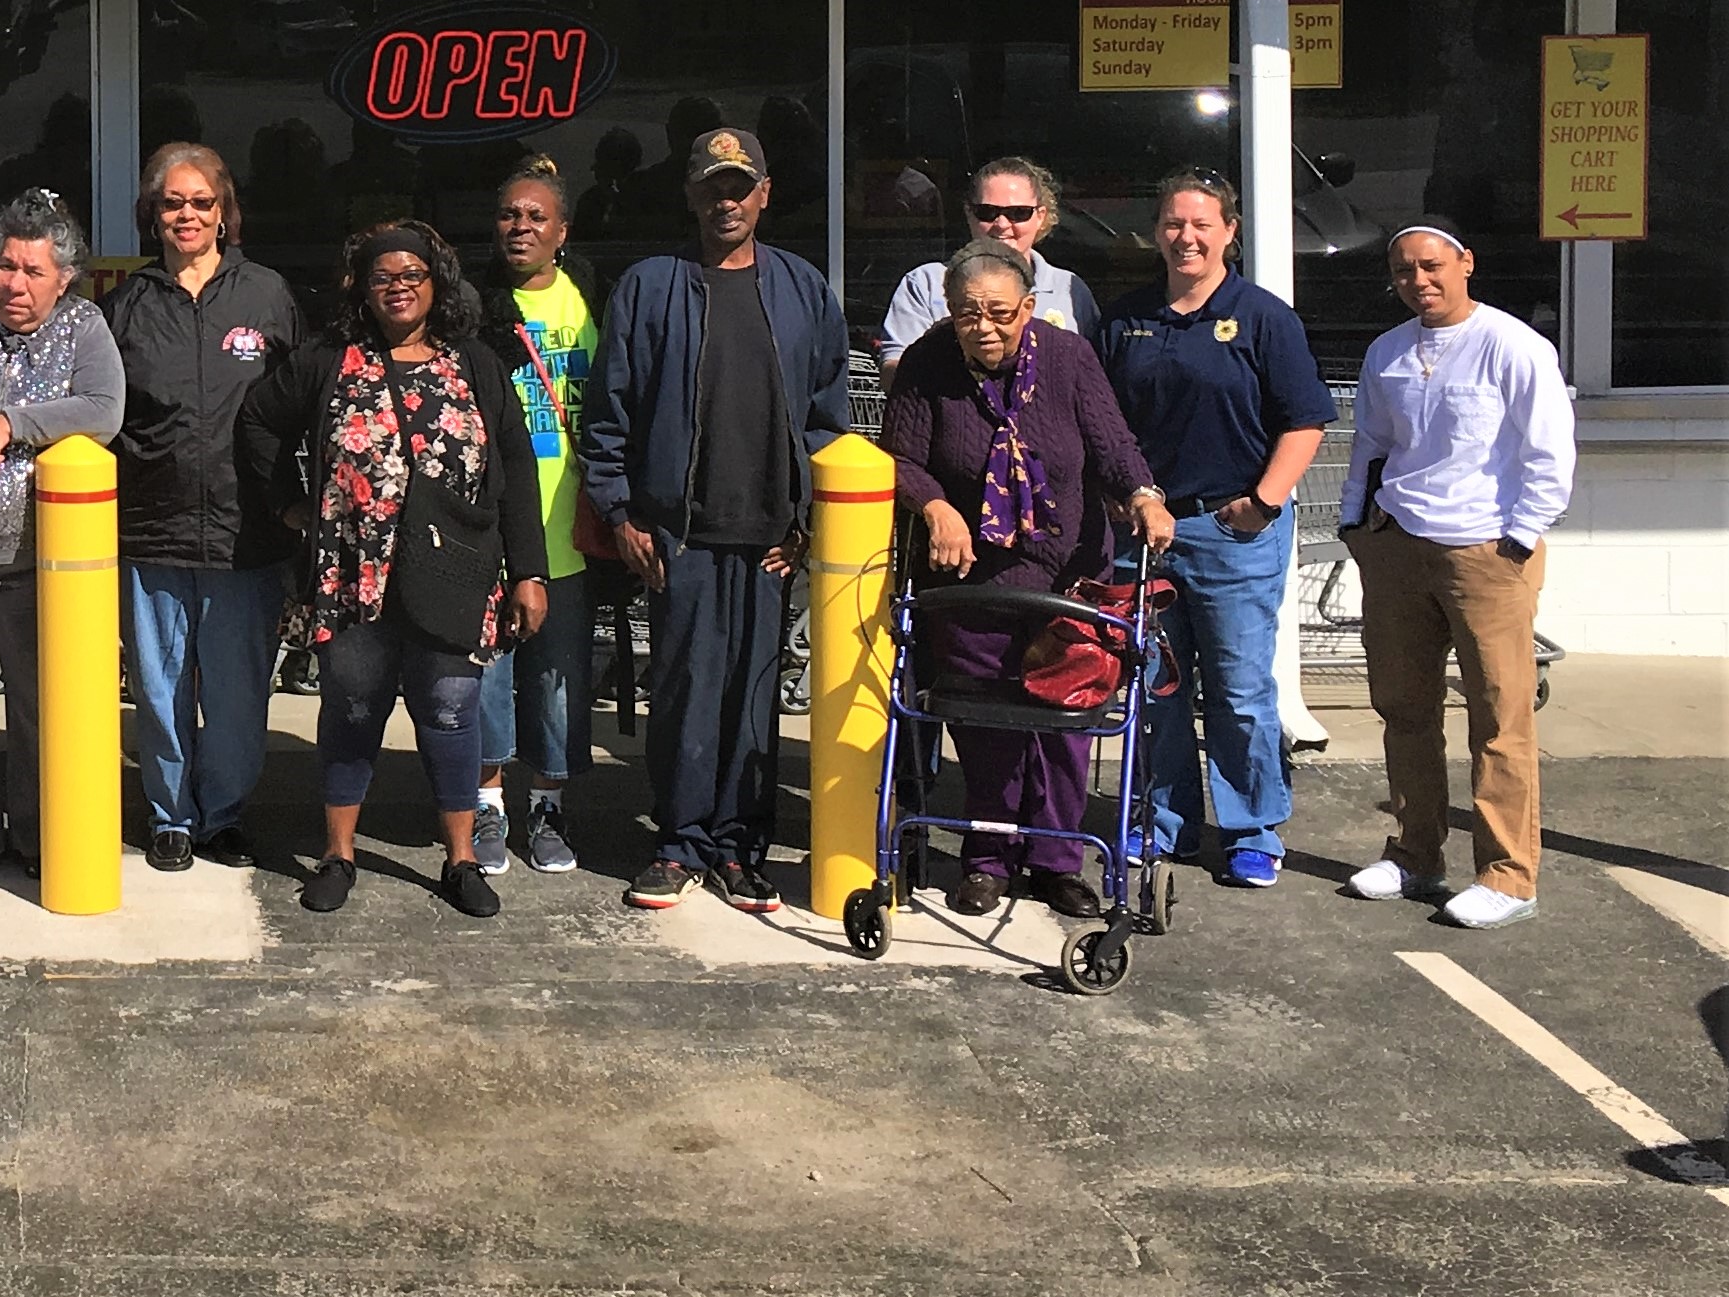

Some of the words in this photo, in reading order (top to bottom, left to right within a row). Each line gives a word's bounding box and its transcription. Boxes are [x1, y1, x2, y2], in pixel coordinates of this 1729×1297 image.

[1093, 14, 1158, 33] Monday
[1172, 13, 1221, 32] Friday
[1294, 12, 1333, 30] 5pm
[1092, 36, 1165, 54] Saturday
[1295, 35, 1333, 53] 3pm
[367, 29, 587, 120] OPEN
[1092, 59, 1152, 78] Sunday
[1550, 101, 1585, 119] GET
[1591, 100, 1639, 118] YOUR
[1550, 125, 1639, 144] SHOPPING
[1570, 150, 1618, 168] CART
[1570, 175, 1617, 193] HERE
